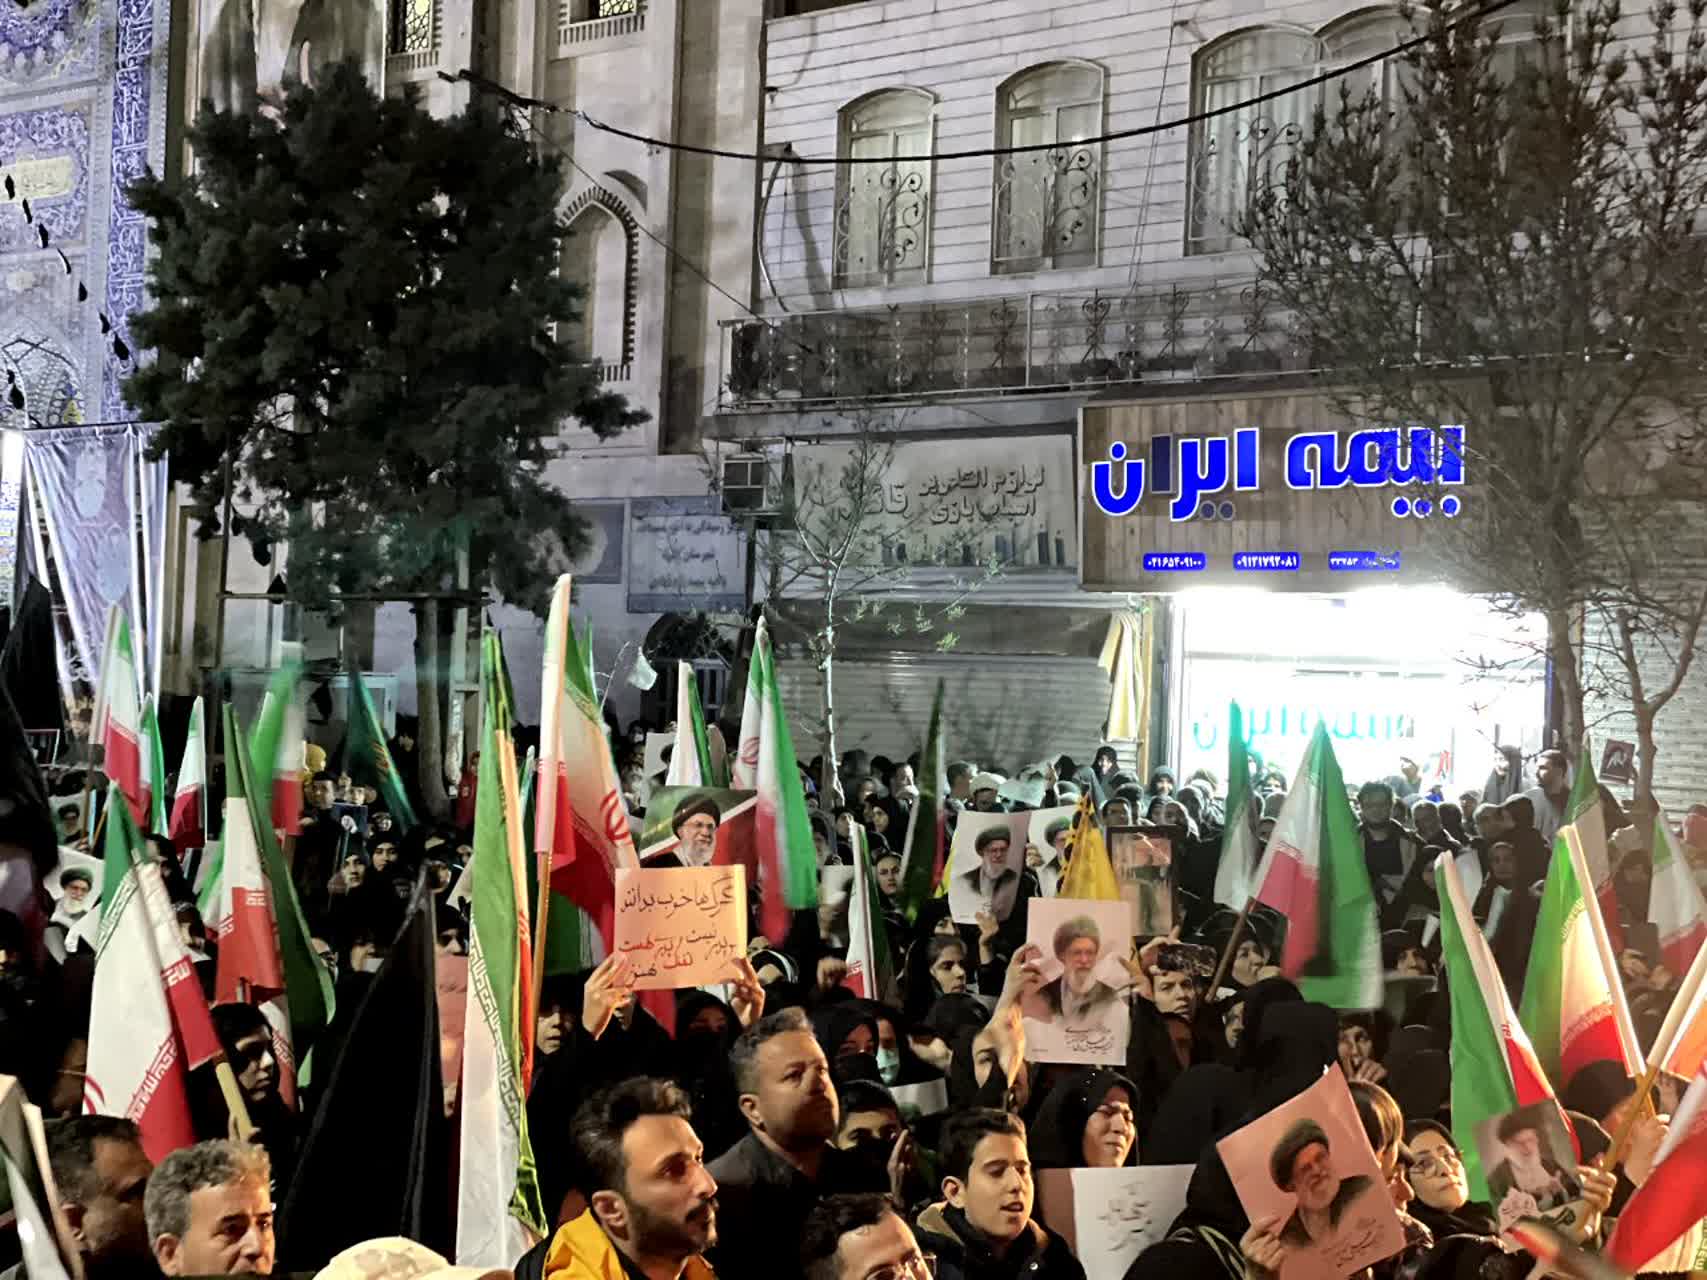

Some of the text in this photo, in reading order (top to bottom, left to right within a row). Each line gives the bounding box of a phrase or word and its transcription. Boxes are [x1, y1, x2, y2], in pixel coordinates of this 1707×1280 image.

[993, 464, 1045, 494] لوازم
[1091, 424, 1466, 522] بیمه ایران
[929, 495, 974, 525] بازی
